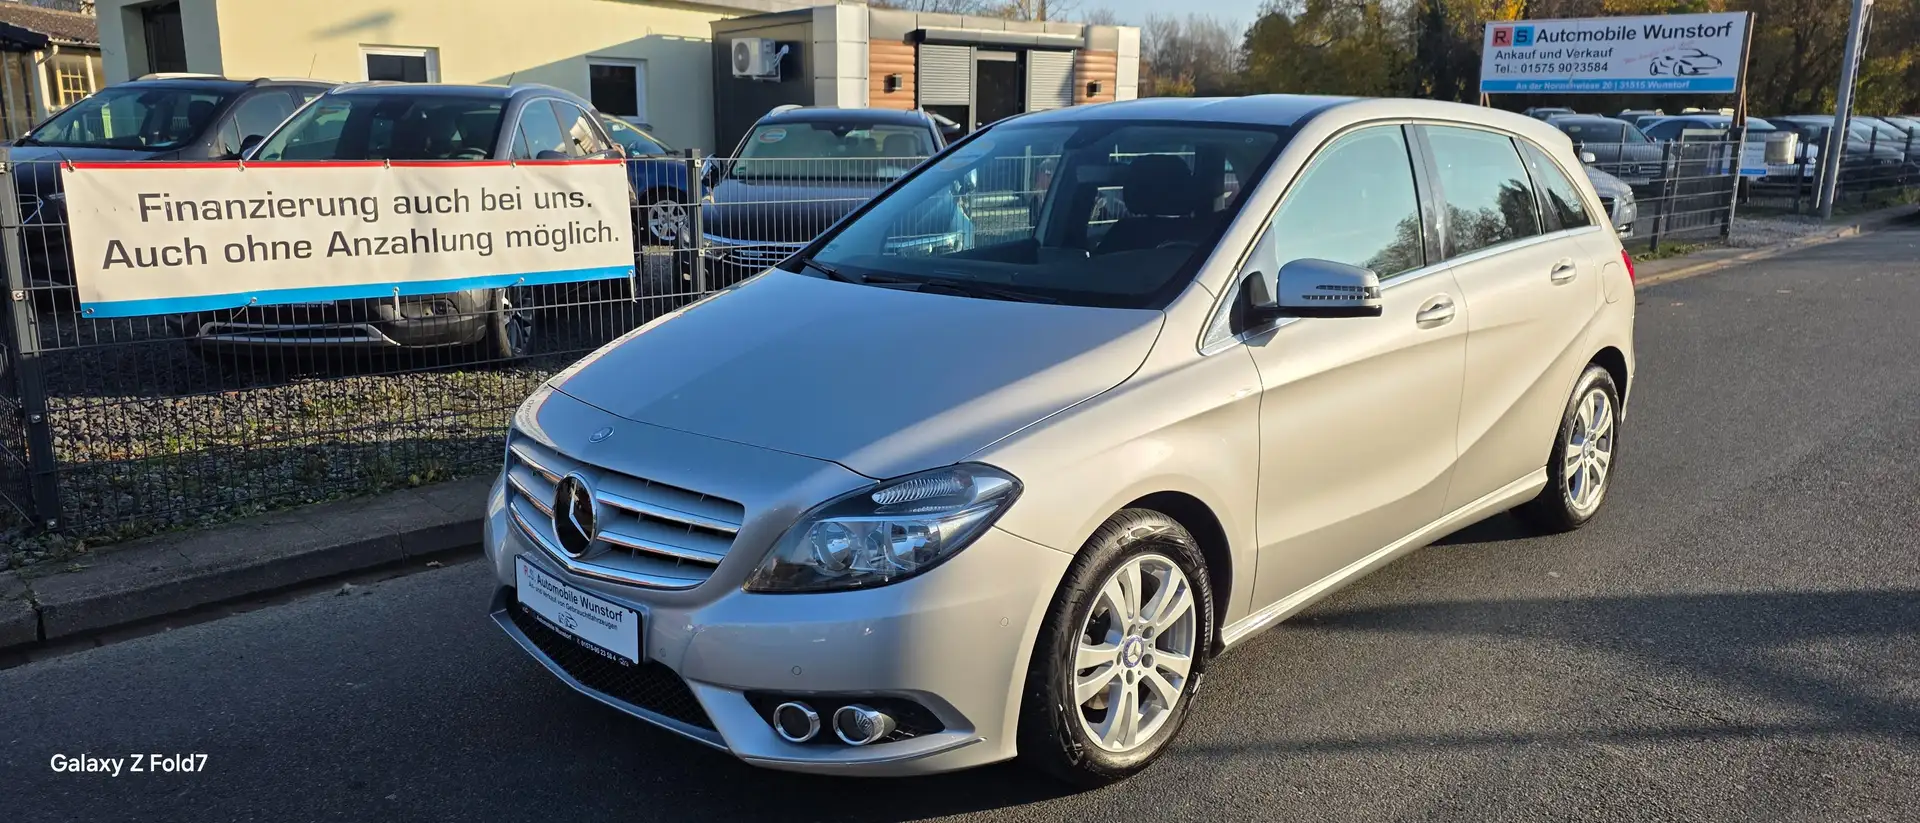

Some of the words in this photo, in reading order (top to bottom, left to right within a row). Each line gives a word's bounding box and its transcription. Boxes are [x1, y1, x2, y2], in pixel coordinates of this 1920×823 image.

[1536, 25, 1637, 43] Automobile
[1643, 21, 1733, 40] Wunstorf
[1495, 49, 1537, 60] Ankauf
[1539, 48, 1562, 59] und
[1566, 47, 1614, 59] Verkauf
[1494, 63, 1518, 74] Tel.:
[1521, 62, 1555, 73] 01575
[1516, 82, 1527, 90] An
[1529, 82, 1542, 90] der
[1619, 80, 1646, 90] 31515
[1648, 80, 1691, 90] Wunstorf
[137, 190, 379, 223] Finanzierung
[393, 187, 470, 215] auch
[480, 186, 522, 213] bei
[534, 187, 593, 210] uns.
[103, 236, 207, 270] Auch
[224, 234, 313, 264] ohne
[326, 227, 492, 258] Anzahlung
[505, 220, 620, 251] möglich.
[537, 573, 578, 605] Automobile
[580, 595, 623, 623] Wunstorf
